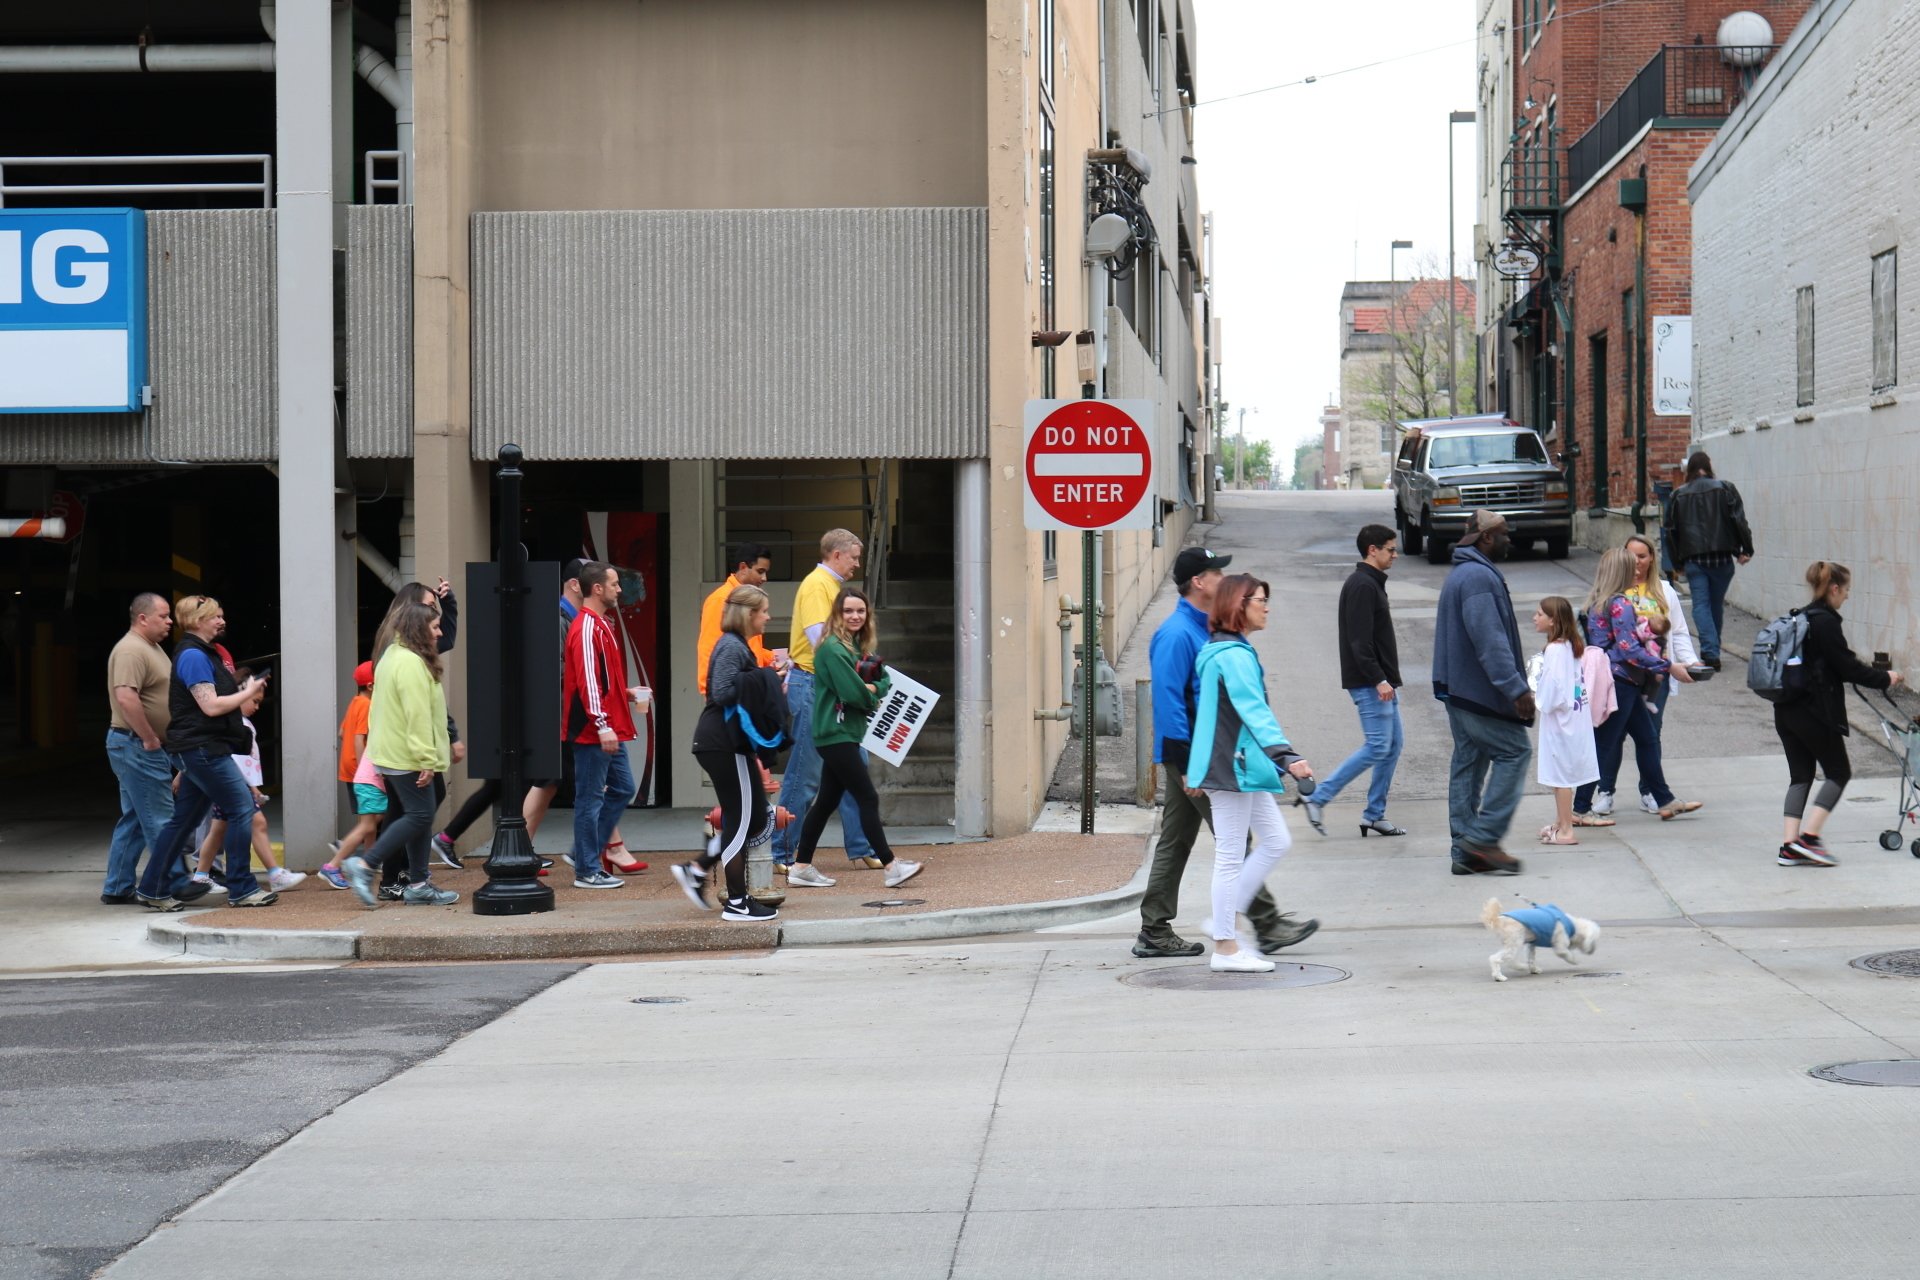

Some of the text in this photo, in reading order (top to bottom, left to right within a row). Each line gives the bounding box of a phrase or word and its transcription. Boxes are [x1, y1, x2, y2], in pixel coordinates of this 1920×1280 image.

[0, 229, 109, 304] G
[1045, 427, 1132, 446] DO NOT
[1053, 484, 1123, 502] ENTER
[872, 690, 909, 740] ENOUGH
[886, 695, 927, 753] I AM MAN
